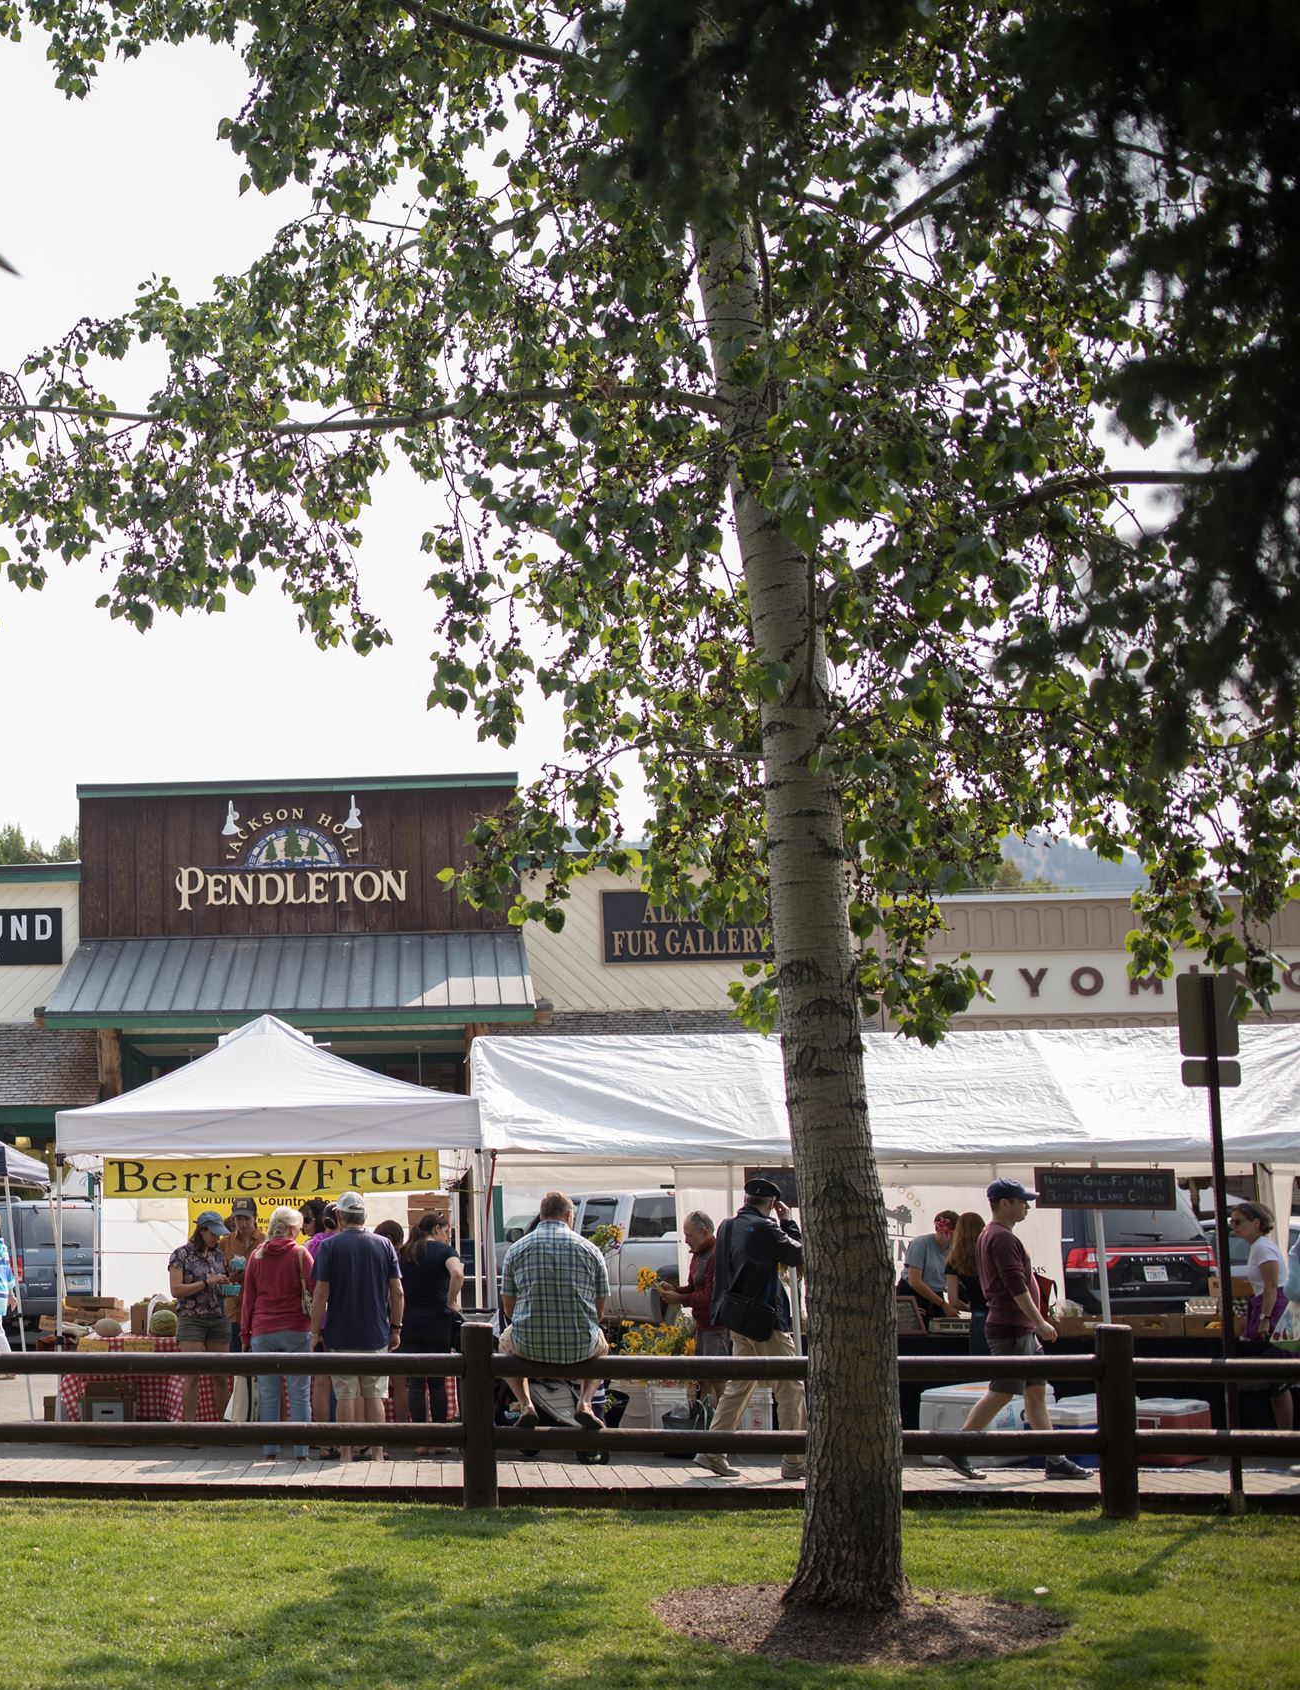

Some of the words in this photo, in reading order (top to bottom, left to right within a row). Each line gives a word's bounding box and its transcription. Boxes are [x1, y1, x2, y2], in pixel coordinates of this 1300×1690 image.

[175, 867, 408, 911] PENDLETON
[612, 929, 659, 956] FUR
[665, 927, 773, 955] GALLERY
[108, 1154, 432, 1193] Berries/Fruit
